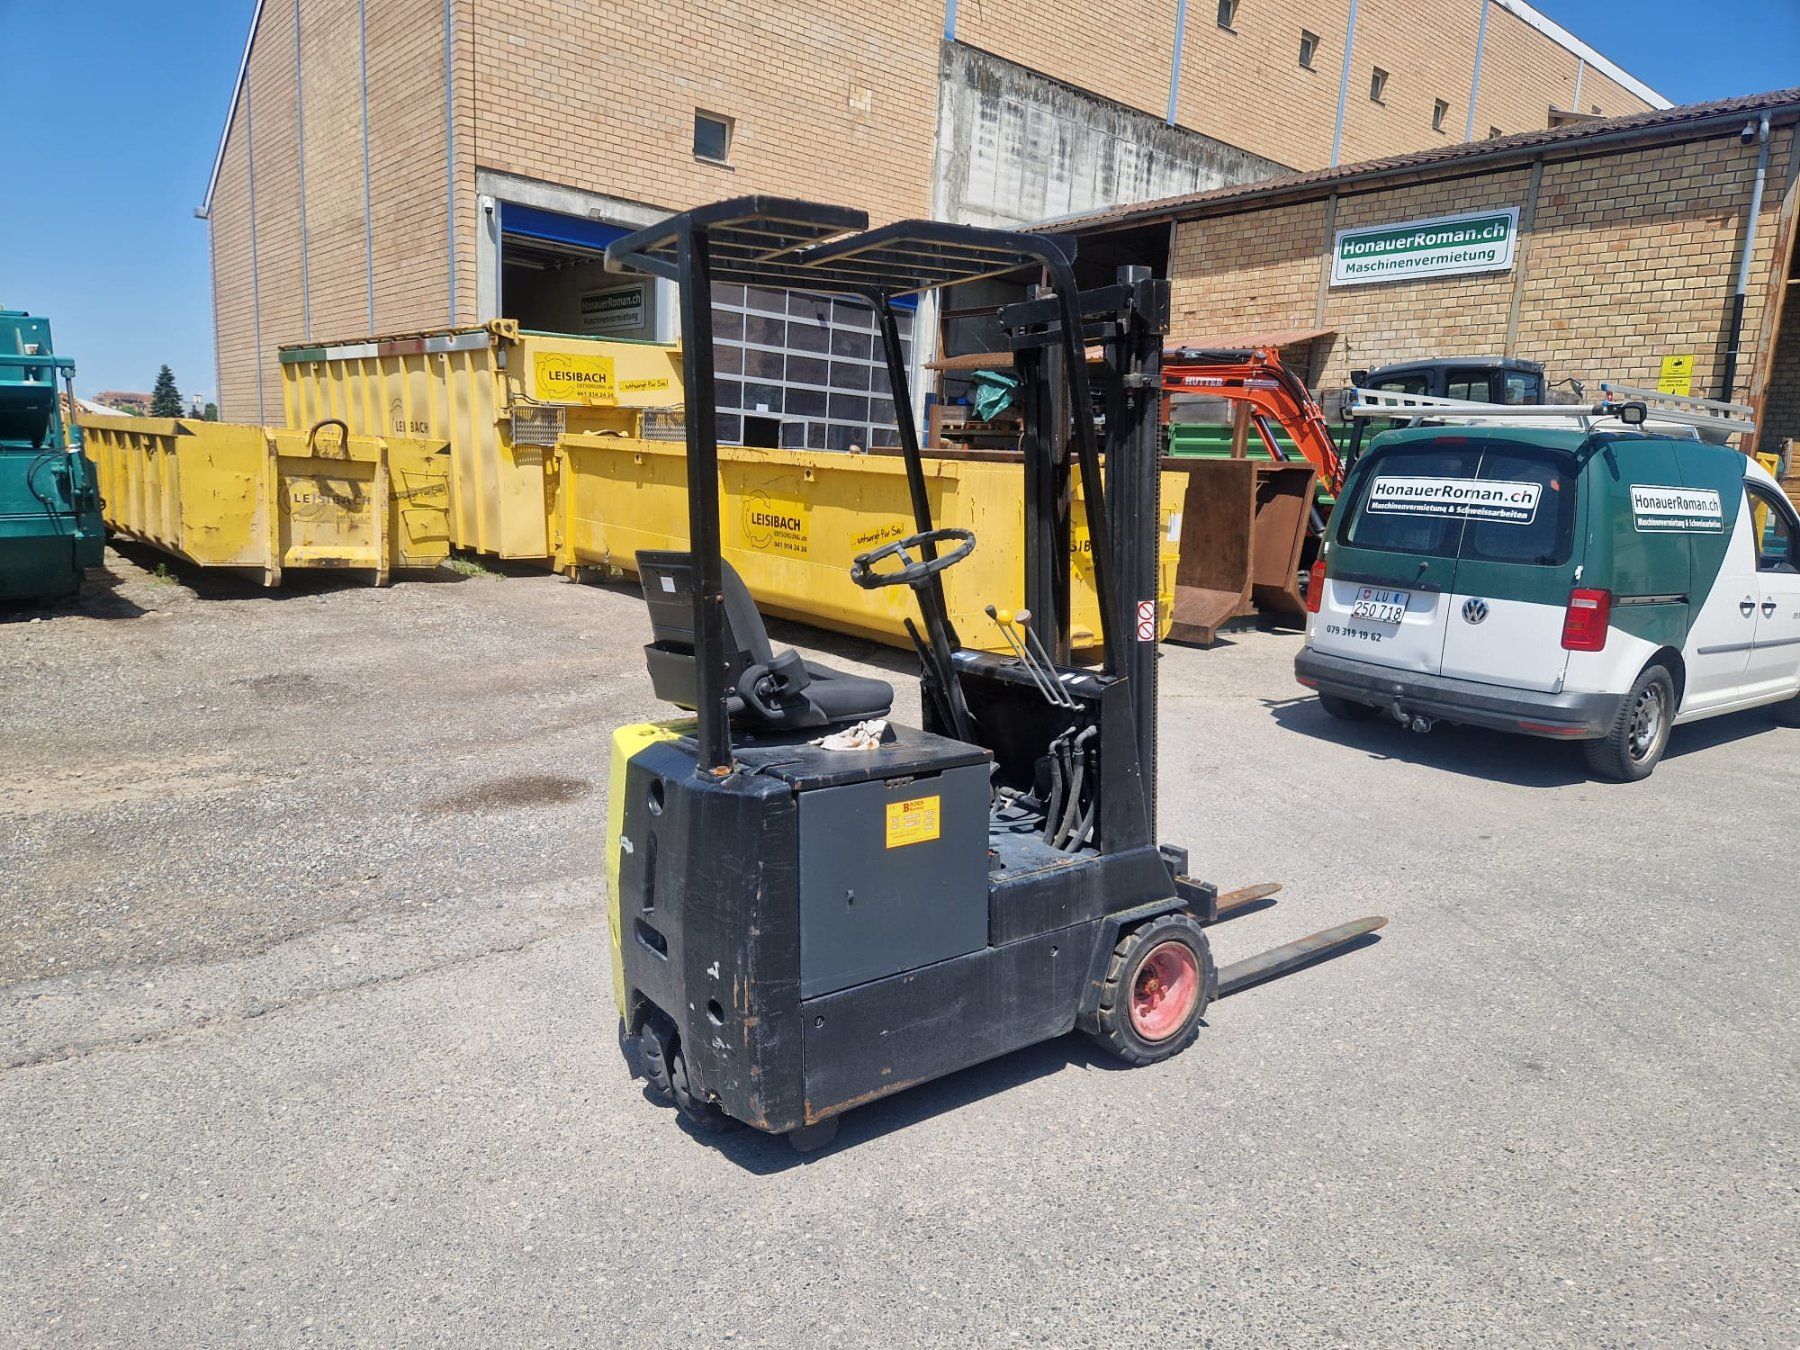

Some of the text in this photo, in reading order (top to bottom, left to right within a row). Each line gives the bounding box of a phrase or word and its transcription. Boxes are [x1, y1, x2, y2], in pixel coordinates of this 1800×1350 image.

[1343, 222, 1504, 256] HonauerRoman.ch
[1345, 248, 1496, 274] Maschinenvermietung
[548, 370, 607, 383] LEISIBACH
[1374, 483, 1533, 504] HonauerRoman.ch
[1634, 493, 1719, 512] HonauerRoman.ch
[1371, 501, 1447, 514] Maschinenvermietung
[1456, 506, 1528, 520] Schweissarbeiten
[751, 511, 801, 532] LEISIBACH
[793, 544, 800, 552] 24
[801, 545, 808, 553] 24
[1375, 590, 1390, 602] LU
[1353, 601, 1377, 617] 250
[1379, 604, 1403, 620] 718
[1326, 624, 1382, 643] 079 319 19 62
